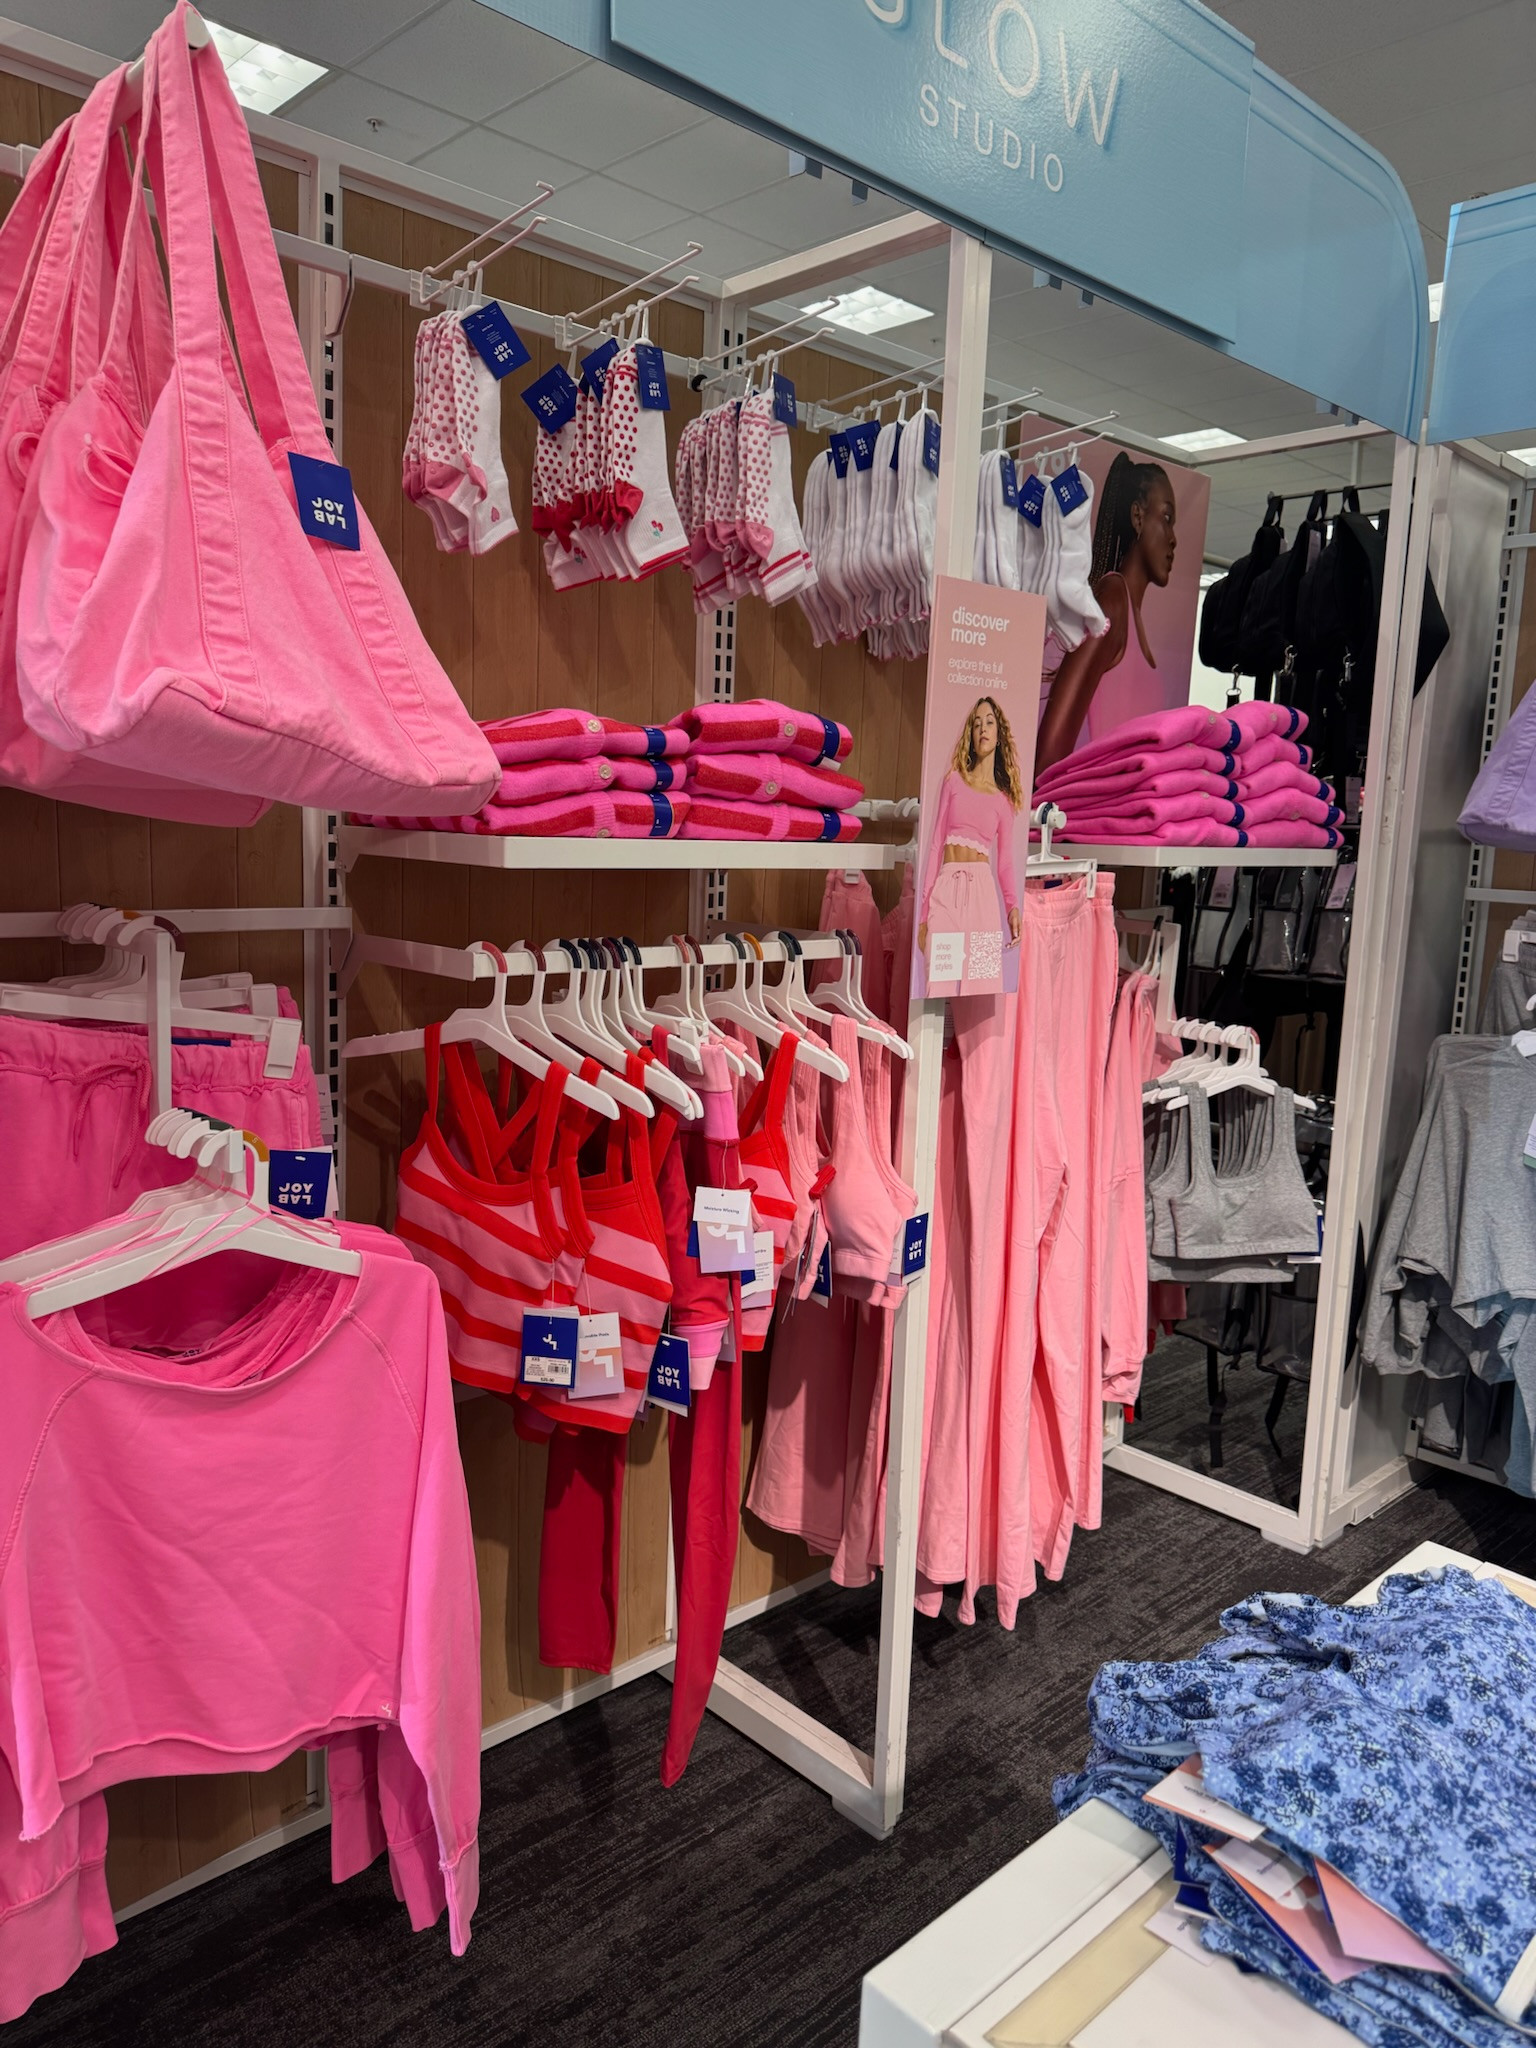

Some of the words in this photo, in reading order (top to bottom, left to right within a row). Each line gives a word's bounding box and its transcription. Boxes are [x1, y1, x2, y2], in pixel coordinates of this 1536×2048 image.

[919, 83, 1063, 192] STUDIO
[311, 497, 344, 515] JOY
[313, 509, 346, 530] LAB
[952, 606, 1010, 632] discover
[951, 627, 987, 646] more
[948, 658, 978, 671] explore
[978, 660, 992, 673] the
[992, 662, 1003, 675] full
[947, 672, 984, 687] collection
[984, 677, 1008, 690] online
[935, 942, 952, 952] shop
[935, 953, 952, 961] more
[935, 962, 953, 972] styles
[278, 1182, 314, 1193] JOY
[278, 1194, 313, 1205] LAB
[909, 1239, 923, 1252] JOY
[908, 1248, 922, 1261] LAB
[656, 1365, 680, 1379] JOY
[657, 1375, 680, 1389] LAB
